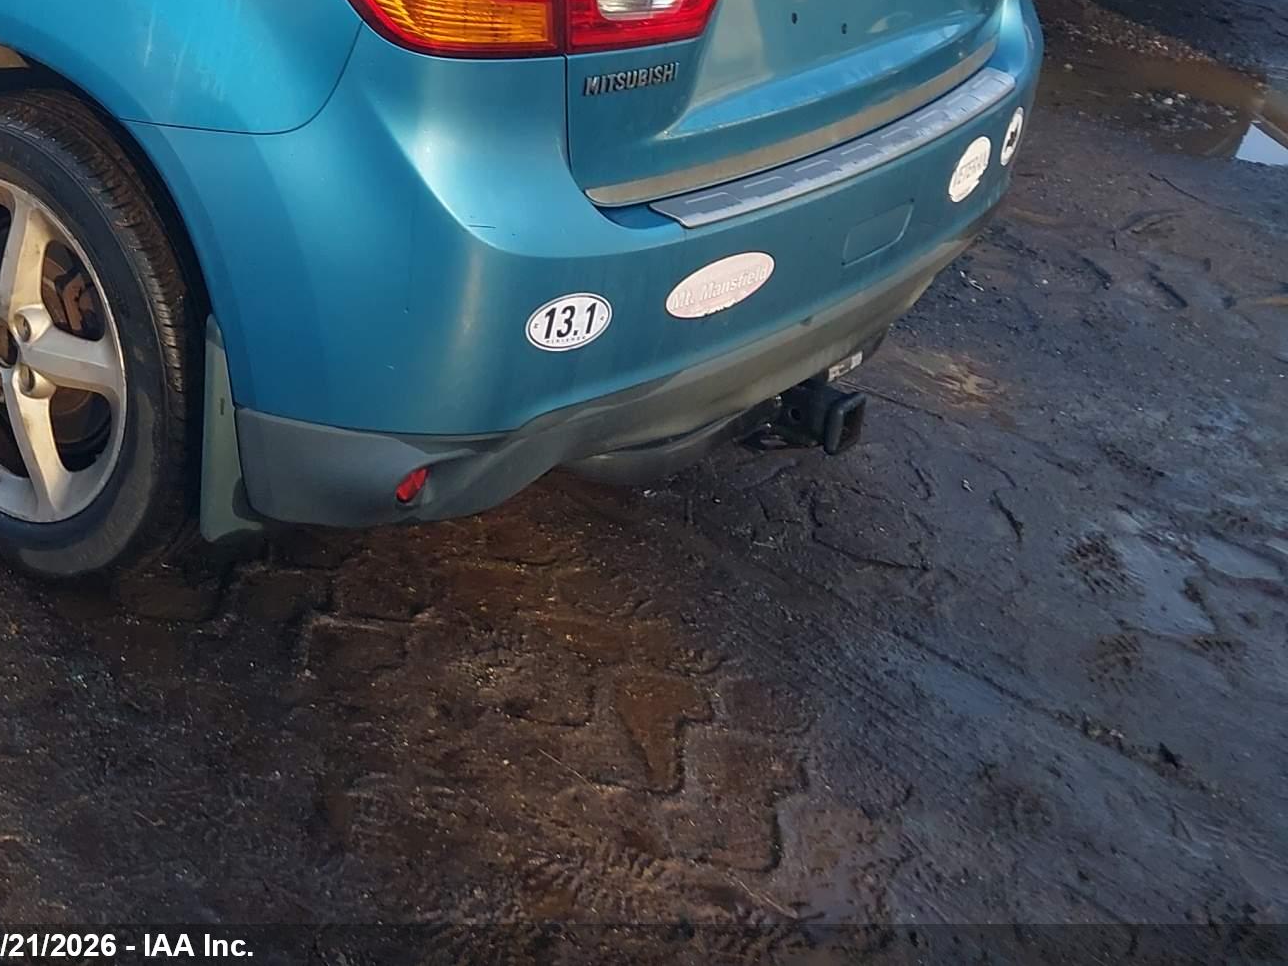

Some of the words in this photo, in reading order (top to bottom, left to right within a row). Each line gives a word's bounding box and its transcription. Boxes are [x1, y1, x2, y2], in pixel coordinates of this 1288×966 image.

[584, 62, 680, 96] MITSUBISHI
[700, 264, 769, 301] Mansfield
[543, 302, 597, 340] 13.1
